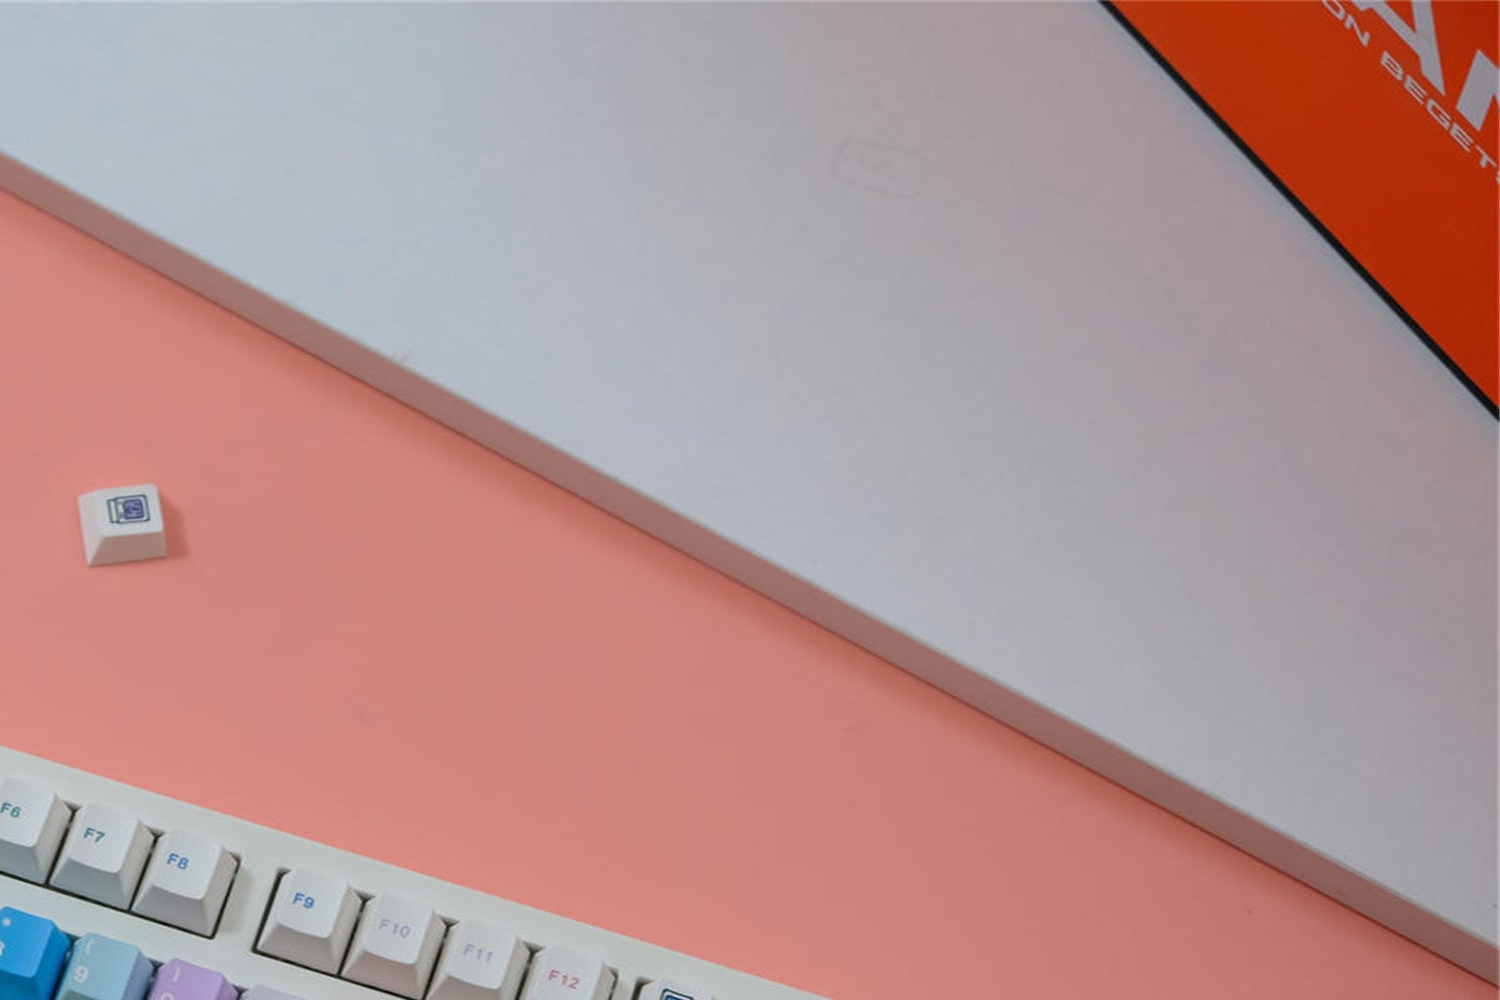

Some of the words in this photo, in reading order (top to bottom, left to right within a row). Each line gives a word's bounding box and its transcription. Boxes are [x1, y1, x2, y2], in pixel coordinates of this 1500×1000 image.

[1380, 51, 1500, 184] BEGET
[0, 802, 21, 819] F6
[83, 827, 106, 843] F7
[167, 852, 189, 870] F8
[292, 892, 315, 909] F9
[379, 918, 410, 939] F10
[463, 943, 493, 963] F11
[74, 965, 89, 983] 9
[547, 969, 580, 989] F12
